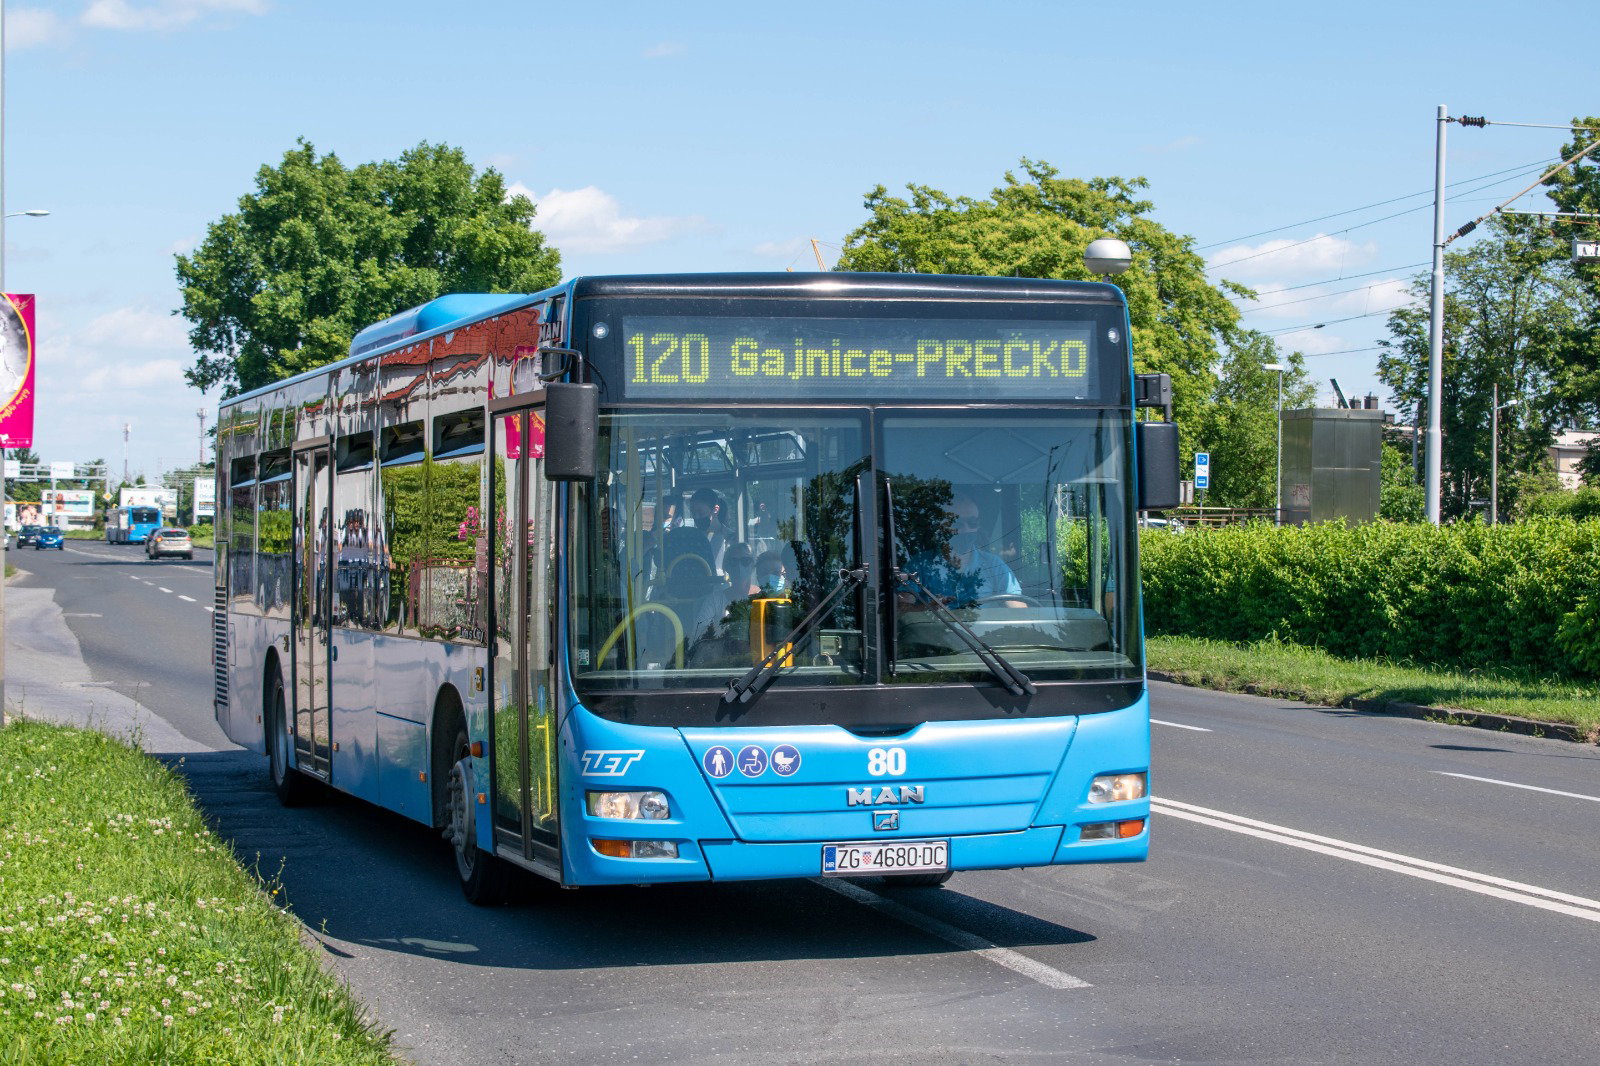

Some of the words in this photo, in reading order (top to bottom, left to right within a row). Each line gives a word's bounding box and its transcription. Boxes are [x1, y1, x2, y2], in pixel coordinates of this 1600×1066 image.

[627, 333, 709, 383] 120
[731, 332, 1087, 380] Gajnice-PREČKO
[581, 749, 646, 777] ZET
[867, 747, 907, 777] 80
[846, 786, 925, 807] MAN
[825, 861, 835, 869] HR
[837, 848, 861, 869] ZG
